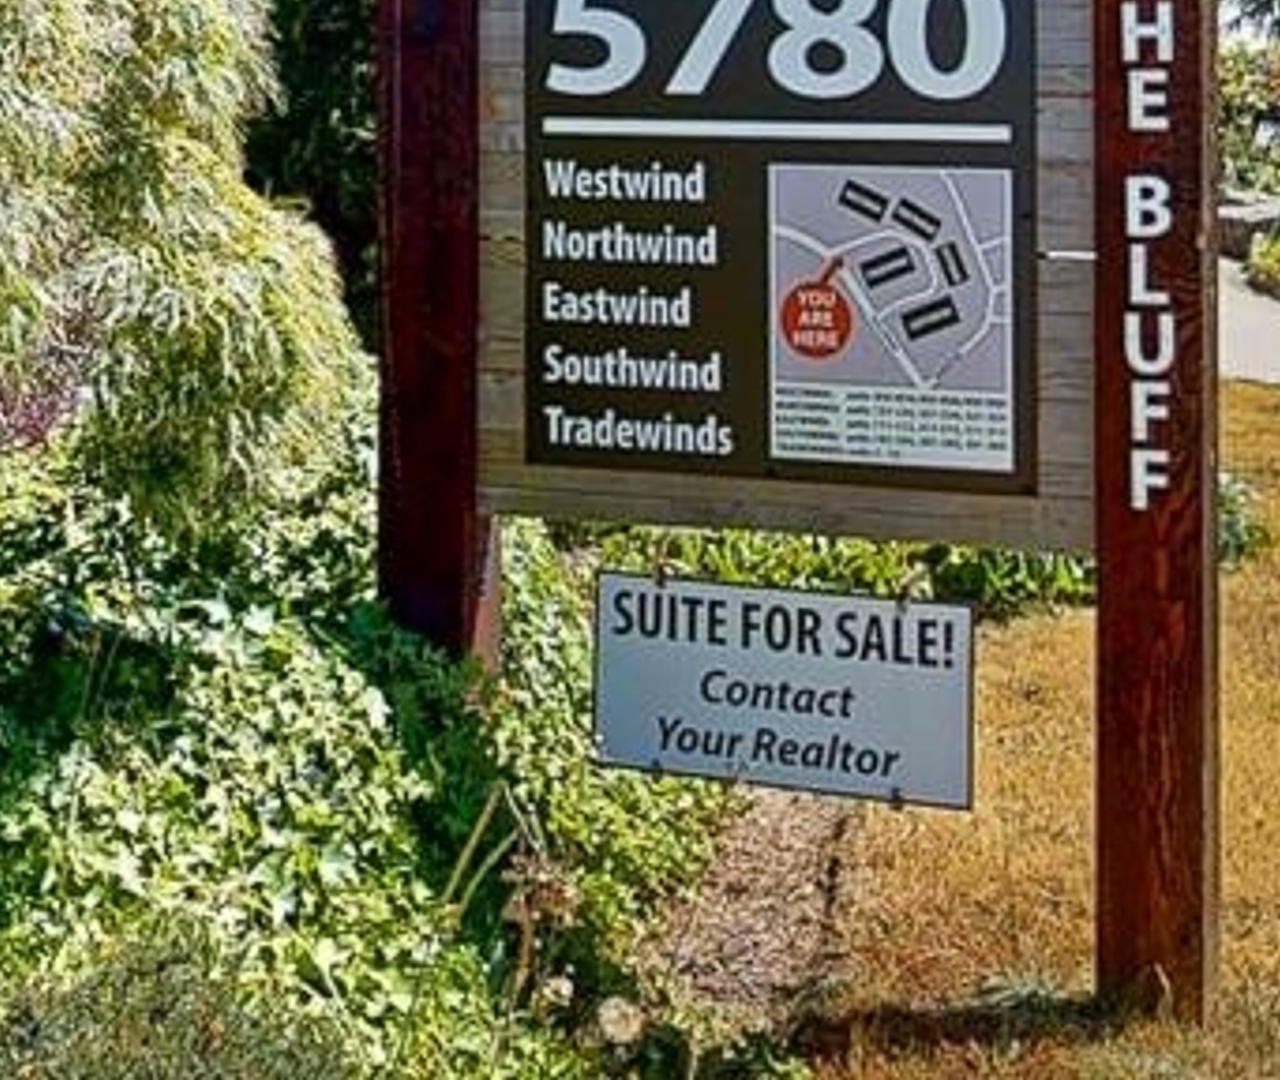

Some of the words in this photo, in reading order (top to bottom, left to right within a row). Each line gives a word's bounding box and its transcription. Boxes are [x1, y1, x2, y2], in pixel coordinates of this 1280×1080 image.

[544, 160, 705, 201] Westwind
[544, 222, 717, 265] Northwind
[544, 283, 691, 327] Eastwind
[797, 291, 837, 307] YOU
[798, 310, 833, 327] ARE
[792, 330, 840, 347] HERE
[1123, 176, 1175, 510] BLUFF
[544, 345, 721, 391] Southwind
[544, 406, 734, 456] Tradewinds
[612, 589, 728, 646] SUITE
[741, 602, 822, 657] FOR
[835, 610, 955, 669] SALE!
[700, 669, 856, 718] Contact
[656, 716, 744, 759] Your
[752, 728, 902, 777] Realtor
